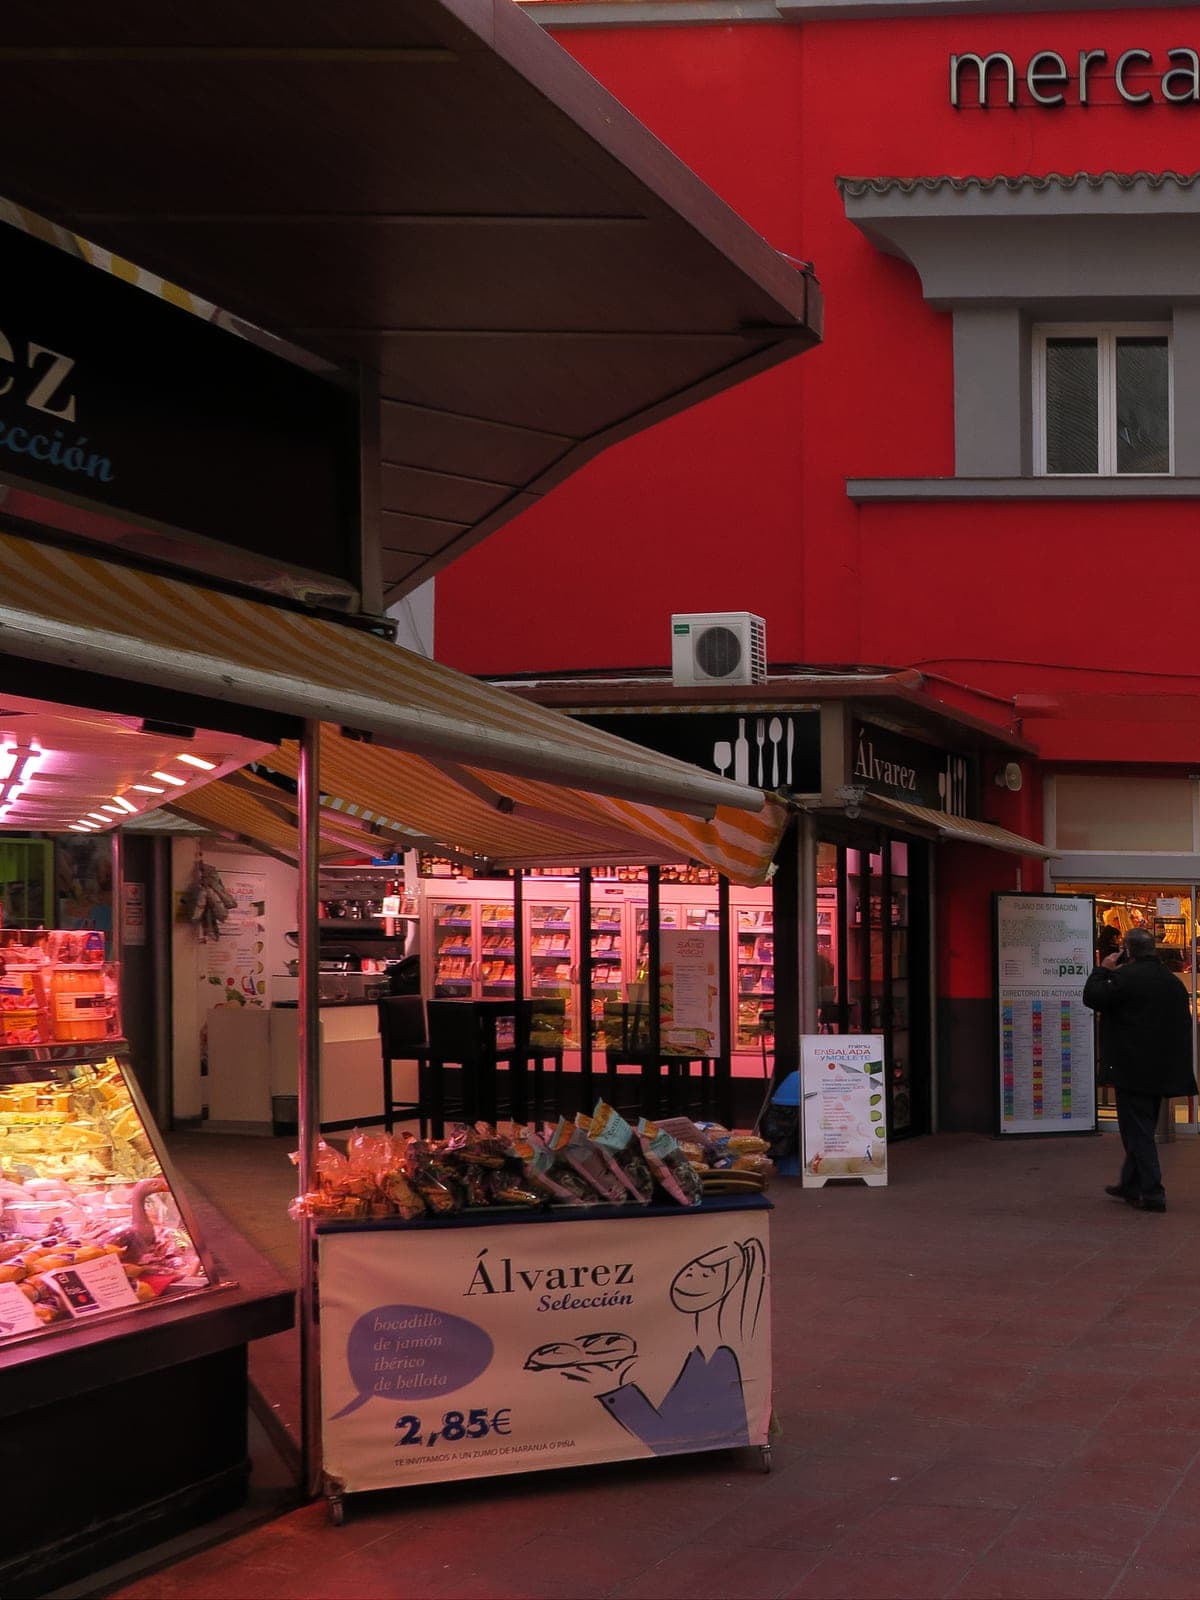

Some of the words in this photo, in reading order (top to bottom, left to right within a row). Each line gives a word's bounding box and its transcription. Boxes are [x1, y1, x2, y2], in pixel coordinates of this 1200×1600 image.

[0, 422, 114, 482] cción
[854, 727, 916, 791] Álvarez
[1059, 965, 1083, 976] paz
[462, 1248, 634, 1296] Álvarez
[536, 1290, 634, 1312] Selección
[373, 1313, 442, 1331] bocadillo
[373, 1338, 392, 1351] de
[395, 1334, 442, 1352] jamón
[374, 1355, 425, 1371] ibérico
[373, 1377, 392, 1391] de
[396, 1372, 448, 1389] bellota
[394, 1408, 512, 1447] 2,85€
[407, 1454, 451, 1466] INVITAMOS
[459, 1452, 472, 1460] UN
[473, 1449, 498, 1458] ZUMO
[499, 1447, 510, 1455] DE
[512, 1443, 548, 1454] NARANJA
[557, 1440, 575, 1449] PIÑA
